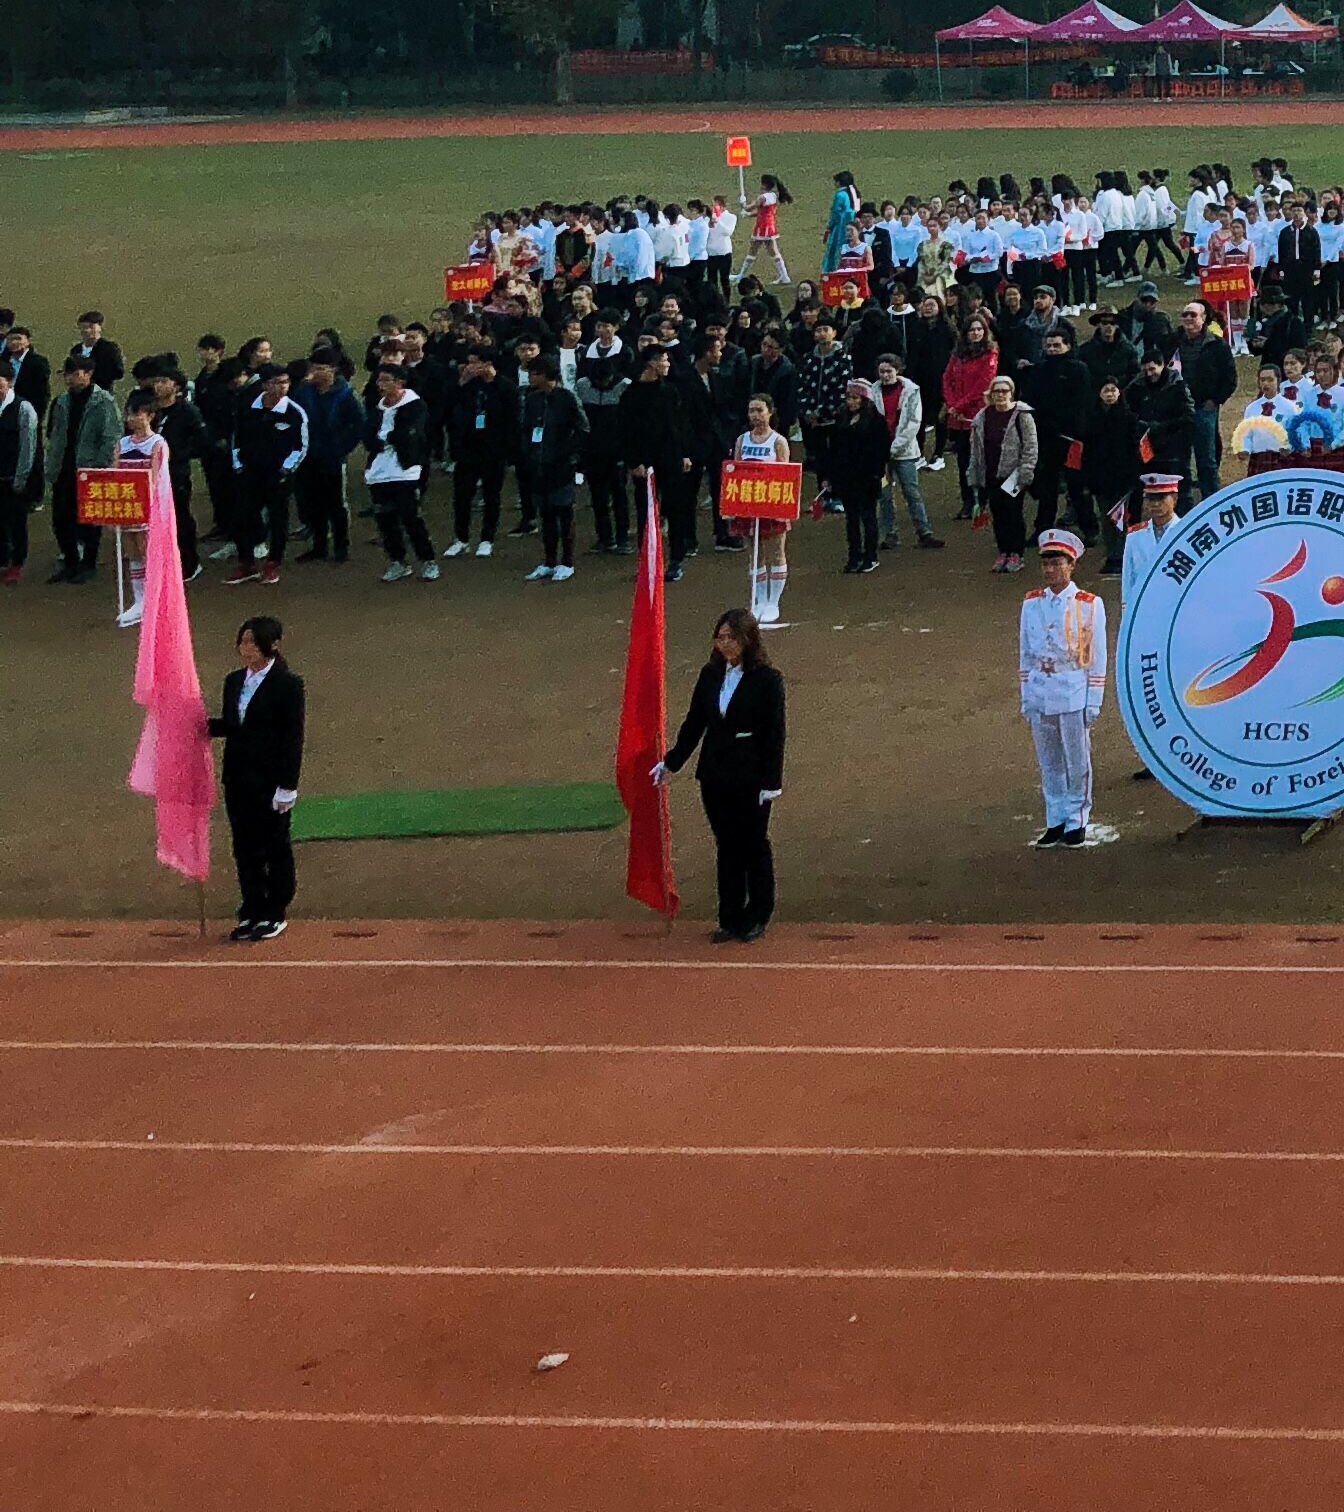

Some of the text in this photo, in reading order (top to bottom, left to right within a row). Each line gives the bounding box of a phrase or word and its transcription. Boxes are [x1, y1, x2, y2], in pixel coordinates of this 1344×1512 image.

[87, 481, 138, 500] 英语系
[725, 477, 795, 505] 外籍教师队
[1140, 650, 1167, 730] Hunan
[1169, 735, 1238, 792] College
[1251, 775, 1279, 796] of
[1242, 721, 1310, 742] HCFS
